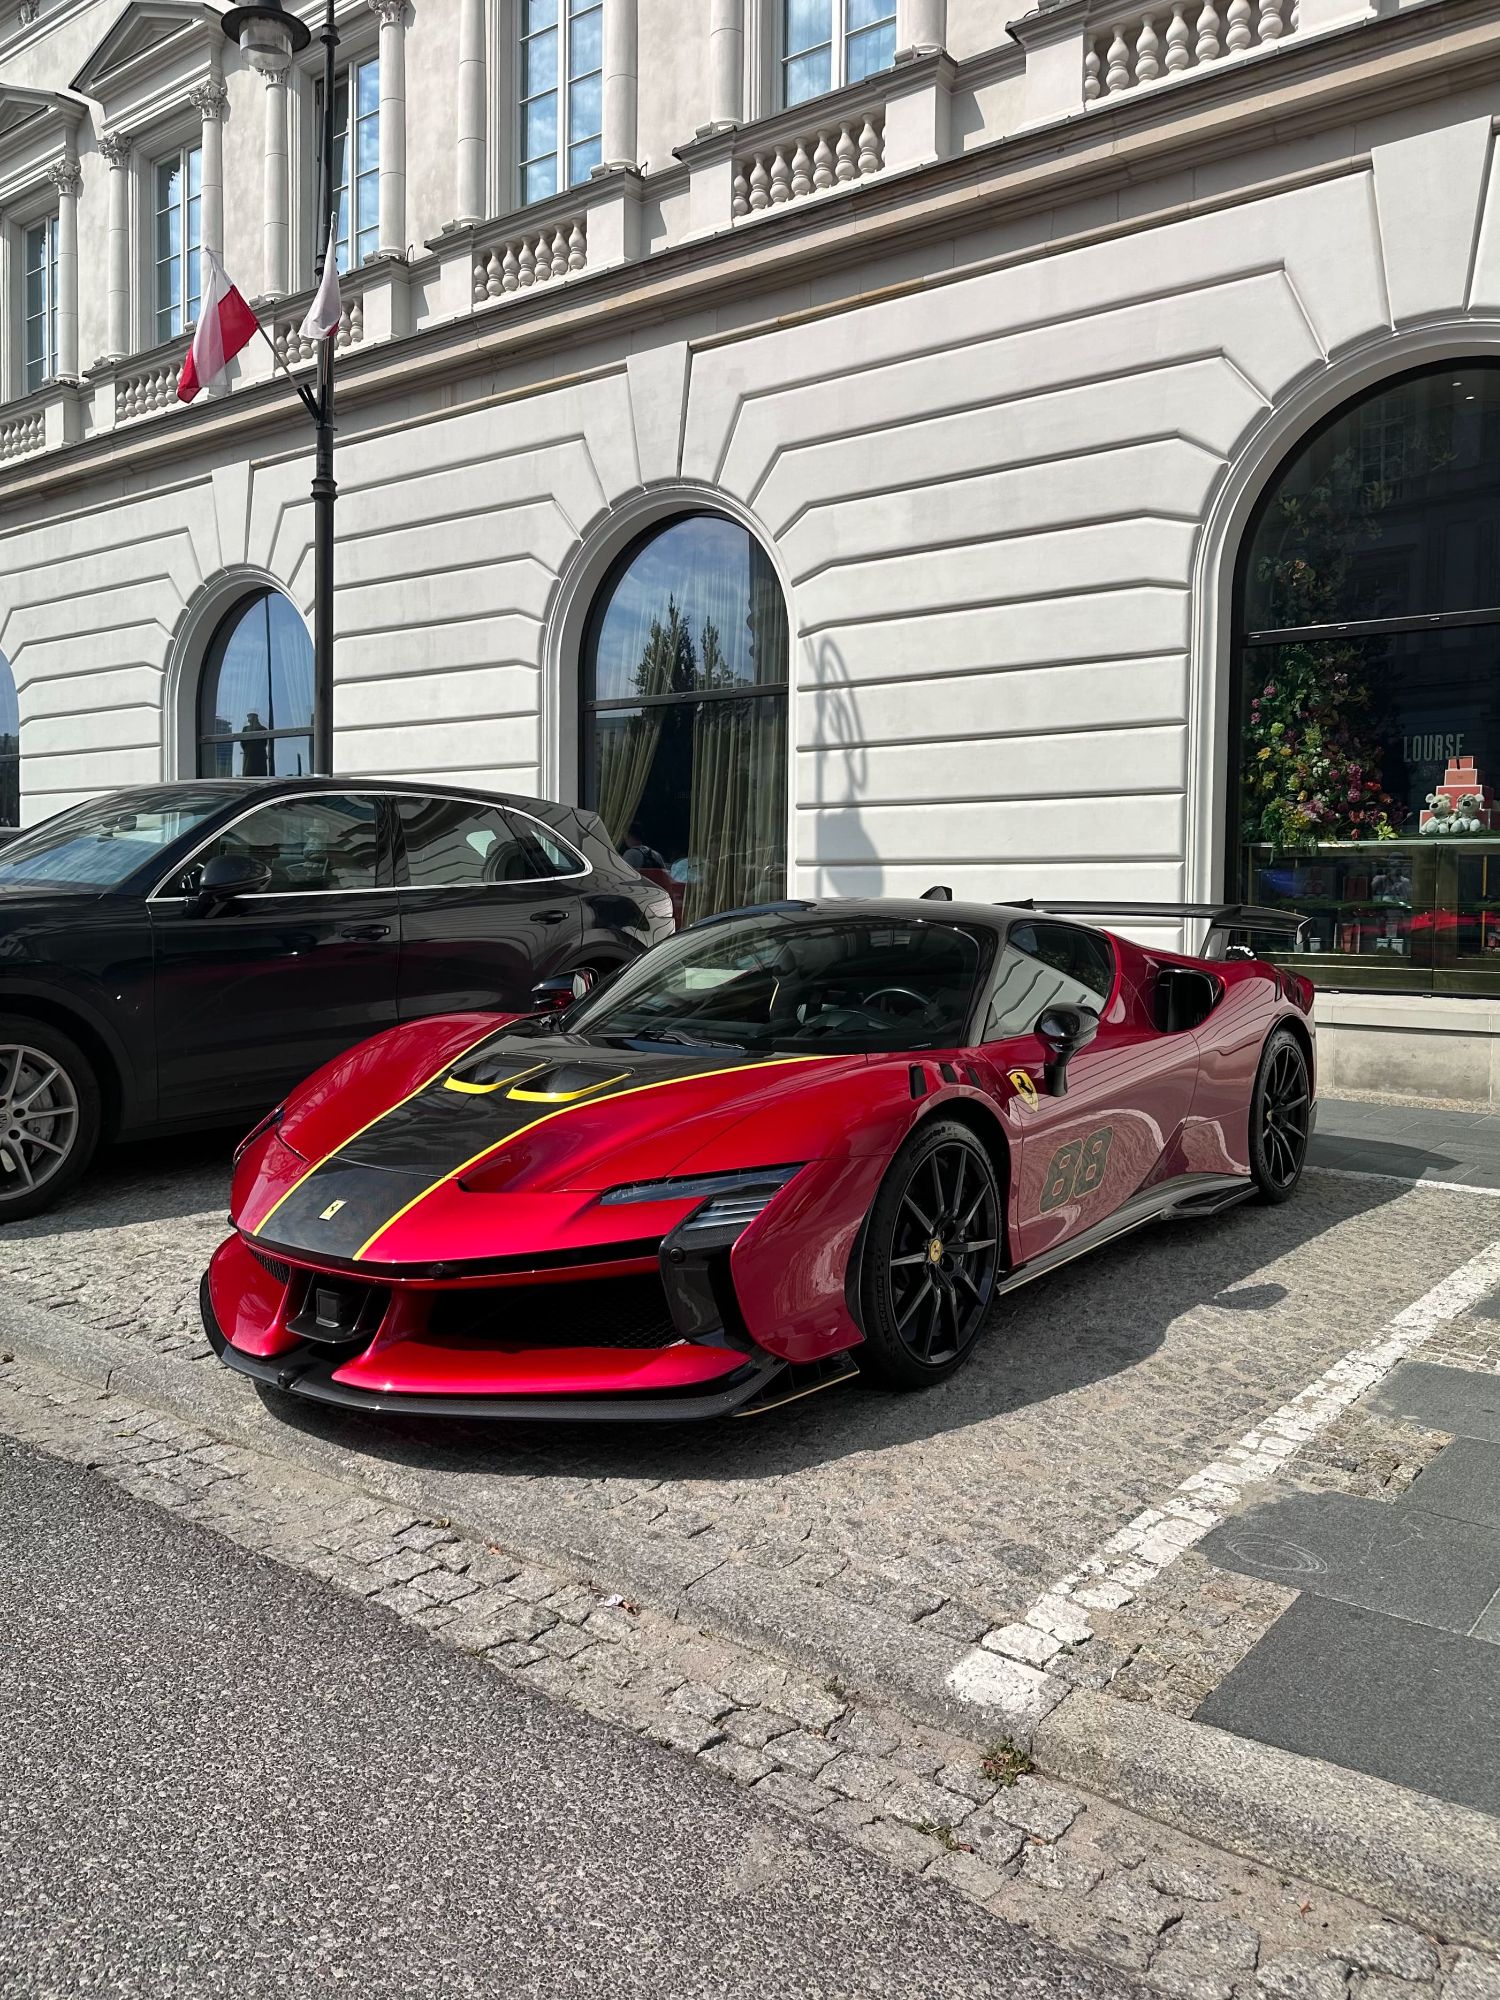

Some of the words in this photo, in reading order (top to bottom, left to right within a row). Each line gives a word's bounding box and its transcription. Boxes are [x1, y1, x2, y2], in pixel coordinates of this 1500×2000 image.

[1403, 733, 1465, 762] LOURSE
[1039, 1125, 1114, 1214] 88
[877, 1277, 890, 1332] MICHELIN
